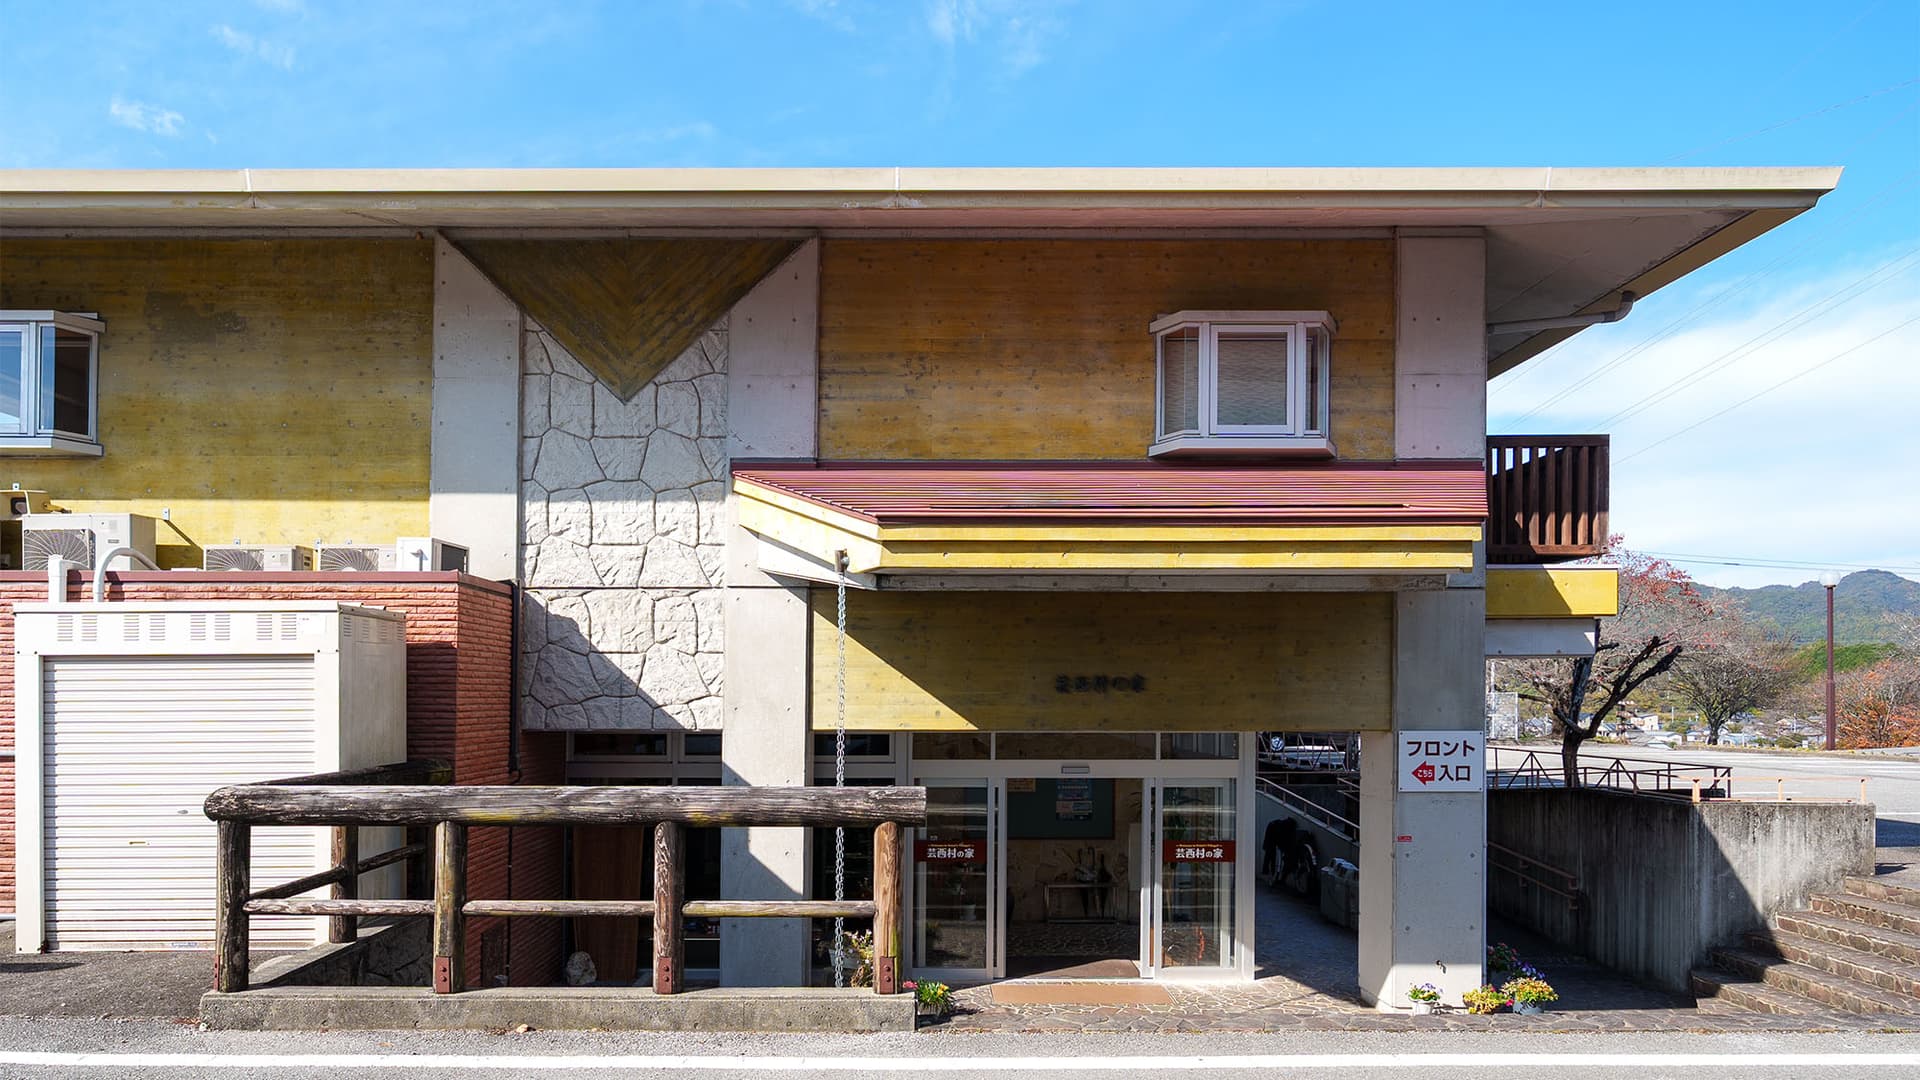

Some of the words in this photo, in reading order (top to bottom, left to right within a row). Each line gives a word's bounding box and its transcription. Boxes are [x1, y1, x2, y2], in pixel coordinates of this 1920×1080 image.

[1406, 740, 1475, 757] フロント
[1417, 769, 1433, 778] こちら
[1438, 765, 1471, 782] 入口
